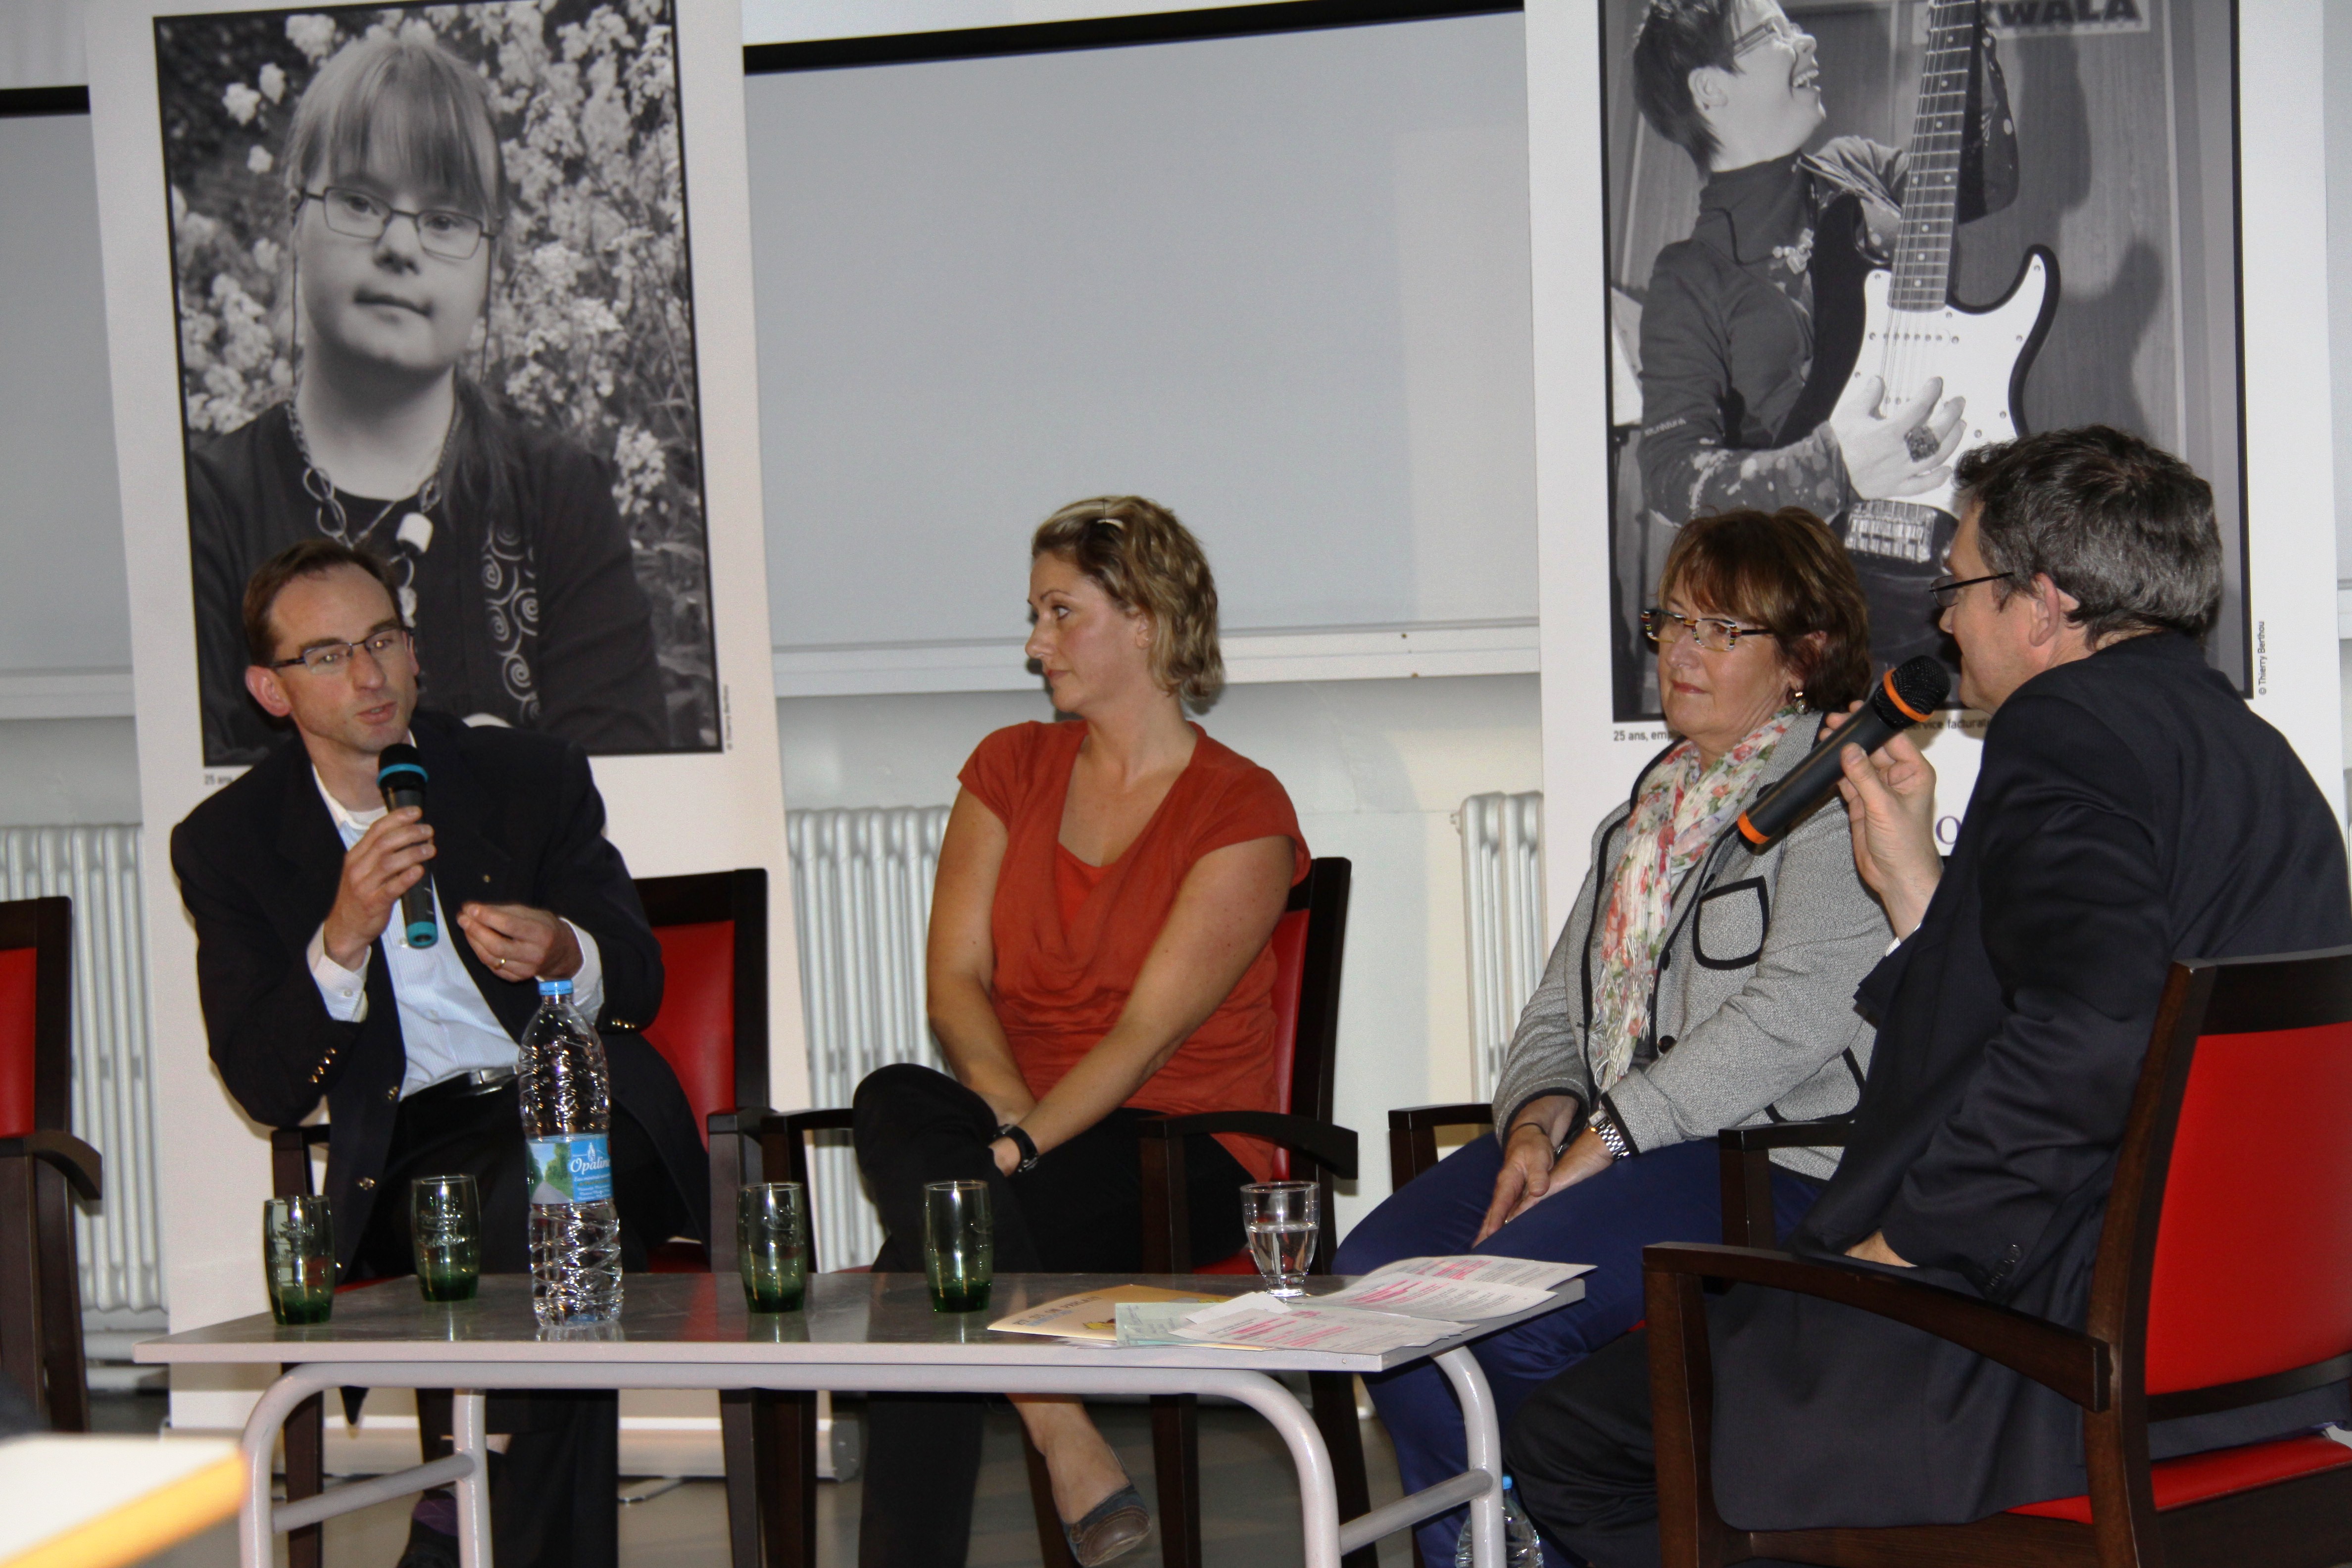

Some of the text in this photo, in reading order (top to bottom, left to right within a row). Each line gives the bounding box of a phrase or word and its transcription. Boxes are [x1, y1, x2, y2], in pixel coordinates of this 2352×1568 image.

[2258, 655, 2267, 686] Thierry
[1613, 730, 1625, 741] 25
[1628, 731, 1649, 742] ans,
